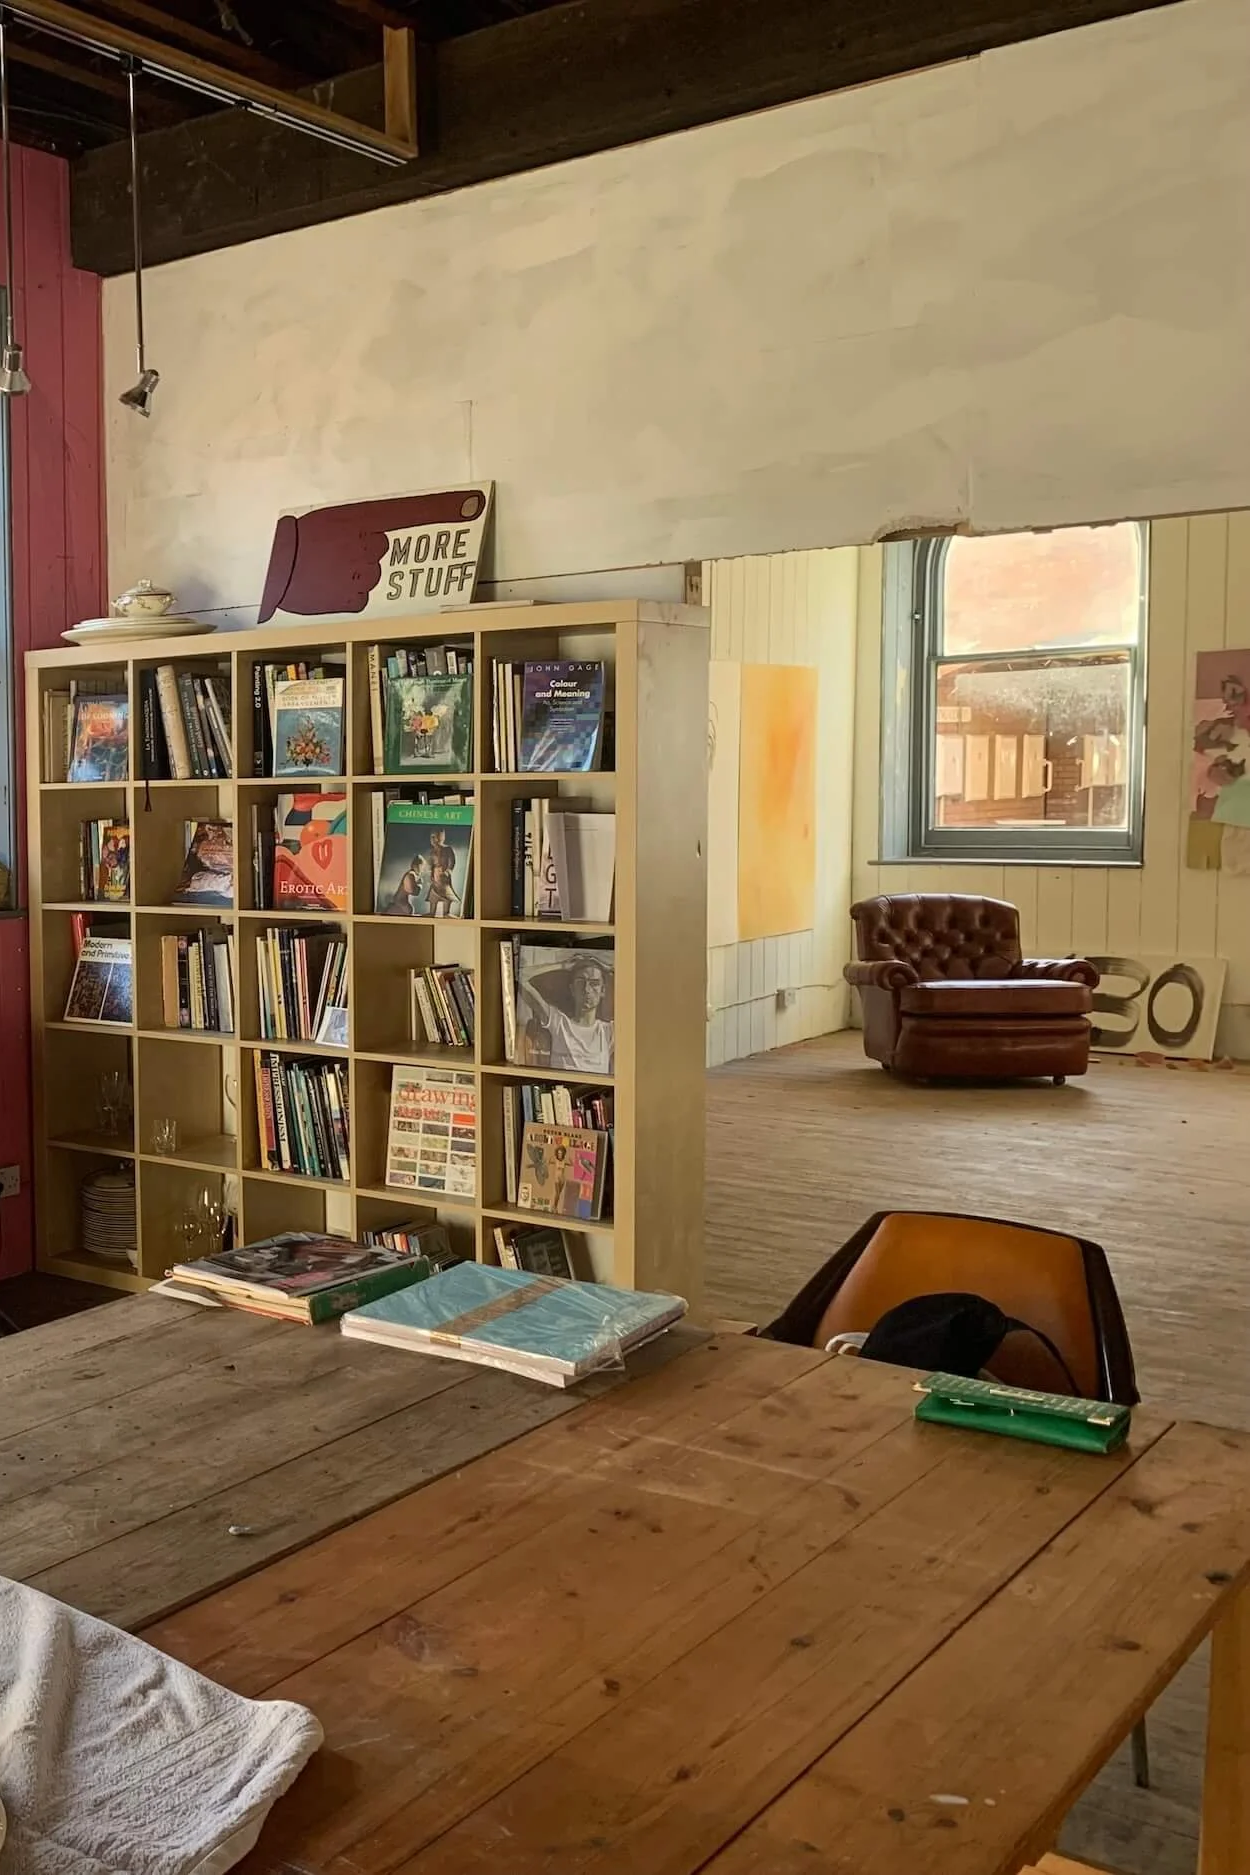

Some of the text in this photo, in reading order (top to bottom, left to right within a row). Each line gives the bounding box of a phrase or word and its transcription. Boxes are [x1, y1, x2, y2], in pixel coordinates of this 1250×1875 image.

[390, 528, 471, 567] MORE
[386, 560, 476, 601] STUFF
[368, 653, 379, 692] MANET
[530, 663, 599, 673] JOHN GAGE
[253, 665, 262, 709] Painting 2.0
[549, 679, 578, 688] Colour
[535, 689, 591, 699] and Meaning
[398, 810, 462, 820] CHINESE ART
[280, 880, 324, 895] EROTIC
[83, 939, 113, 949] Modern
[81, 949, 130, 959] and Primitive
[269, 1052, 287, 1142] IMPRESSIONISM
[399, 1082, 476, 1111] drawing
